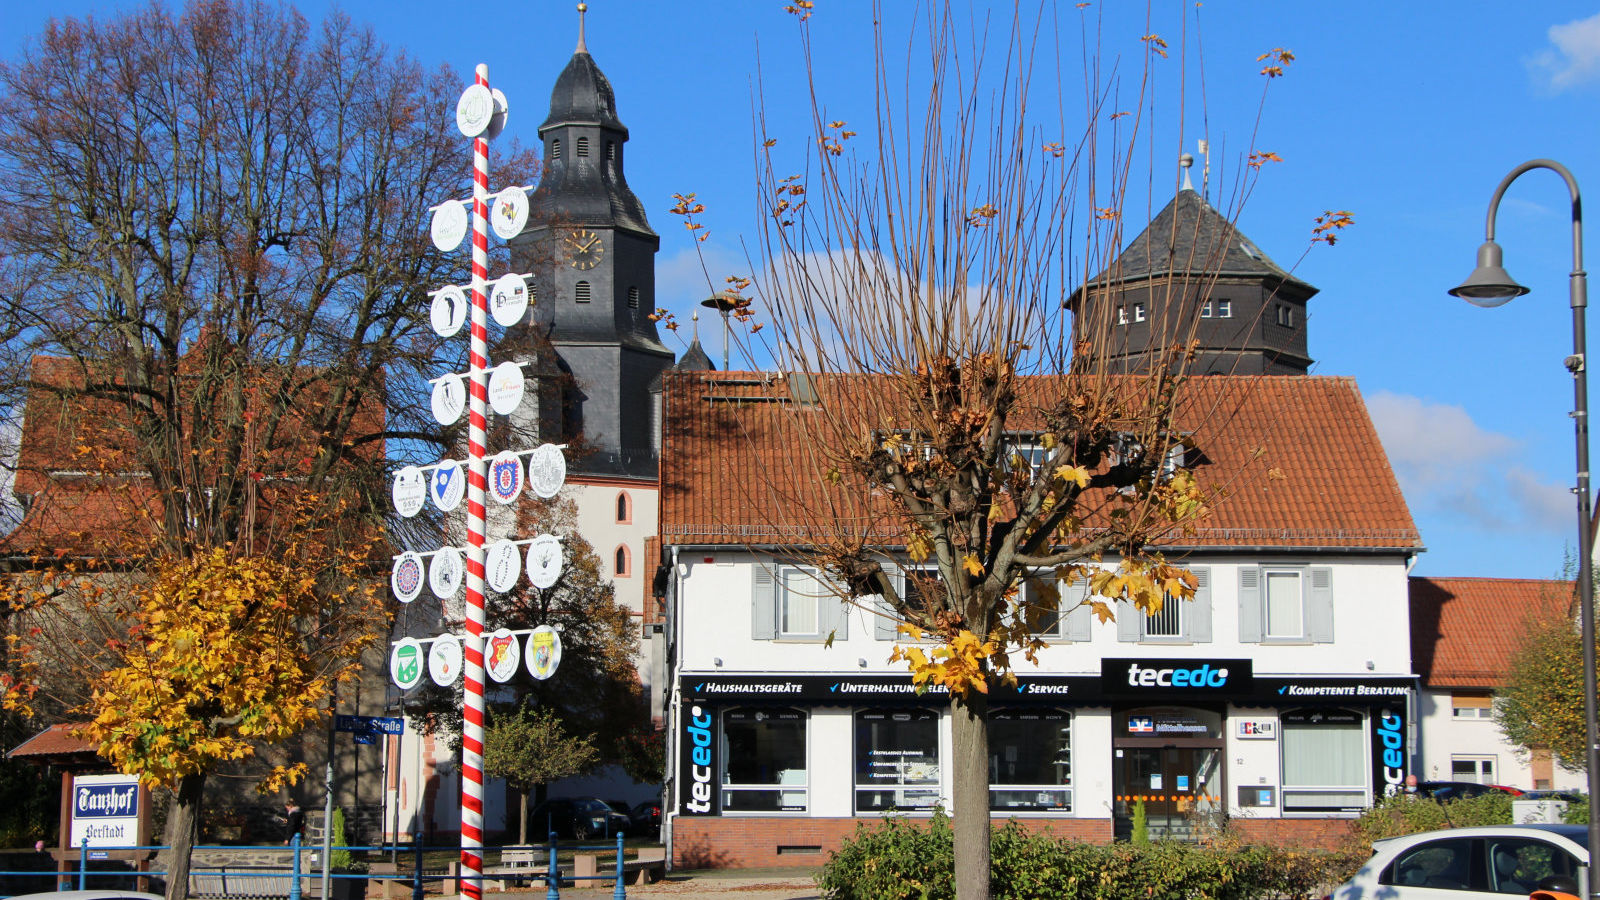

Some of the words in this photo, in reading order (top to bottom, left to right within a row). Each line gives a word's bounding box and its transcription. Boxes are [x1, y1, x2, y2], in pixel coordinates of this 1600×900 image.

[1128, 663, 1229, 687] tecedo
[705, 682, 803, 694] HAUSHALTSGERÄTE
[1028, 683, 1069, 694] SERVICE
[1288, 685, 1355, 696] KOMPETENTE
[372, 719, 401, 732] Straße
[686, 705, 712, 813] tecedo
[1377, 709, 1404, 798] ecedo
[1236, 758, 1244, 766] 12
[78, 786, 135, 815] Tanzhof
[86, 823, 124, 839] Berstadt
